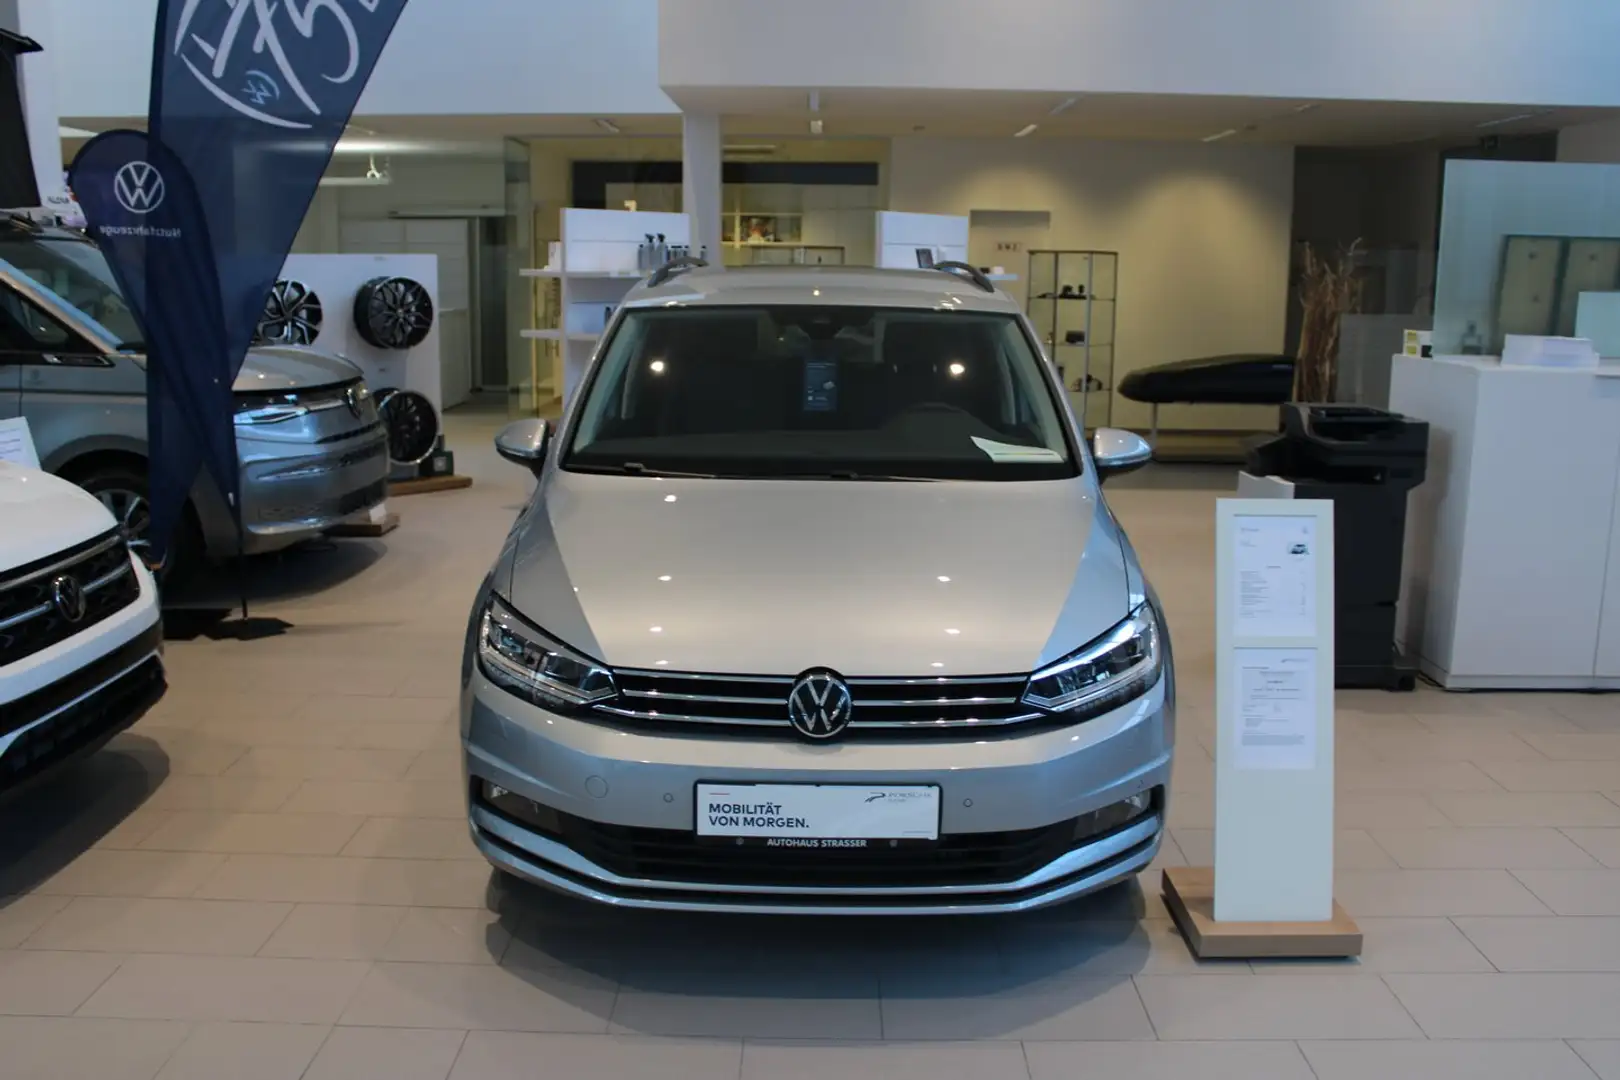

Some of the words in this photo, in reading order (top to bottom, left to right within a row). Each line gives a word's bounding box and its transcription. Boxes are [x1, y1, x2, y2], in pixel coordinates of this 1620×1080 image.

[114, 160, 165, 213] VW
[789, 674, 852, 739] VW
[708, 802, 782, 816] MOBILITÄT
[709, 815, 740, 827] VON
[743, 817, 810, 829] MORGEN.
[766, 838, 819, 848] AUTOHAUS
[821, 839, 868, 848] STRASSER
